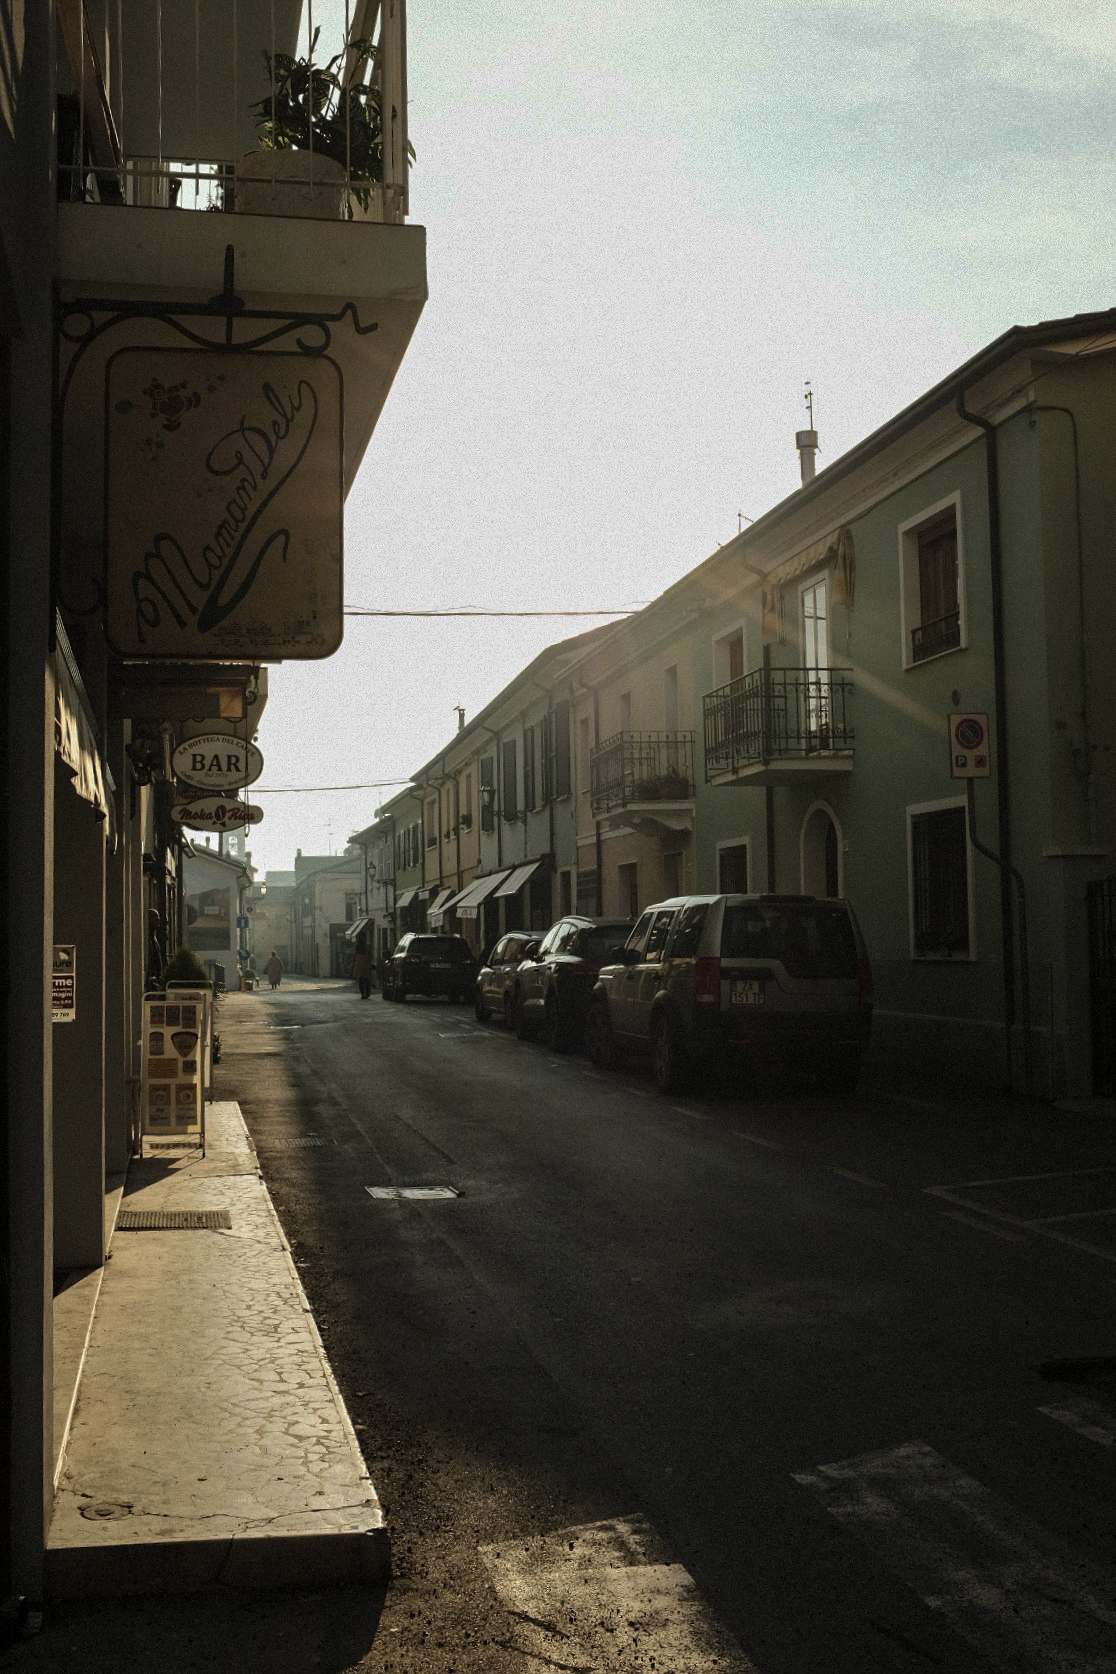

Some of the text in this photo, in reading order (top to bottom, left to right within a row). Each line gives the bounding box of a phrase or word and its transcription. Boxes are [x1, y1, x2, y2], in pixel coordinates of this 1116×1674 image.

[205, 379, 312, 480] Deli
[178, 746, 188, 755] LA
[188, 737, 220, 749] BOTTEGA
[222, 737, 234, 746] DEL
[190, 753, 242, 772] BAR
[179, 807, 255, 820] Moka Rica
